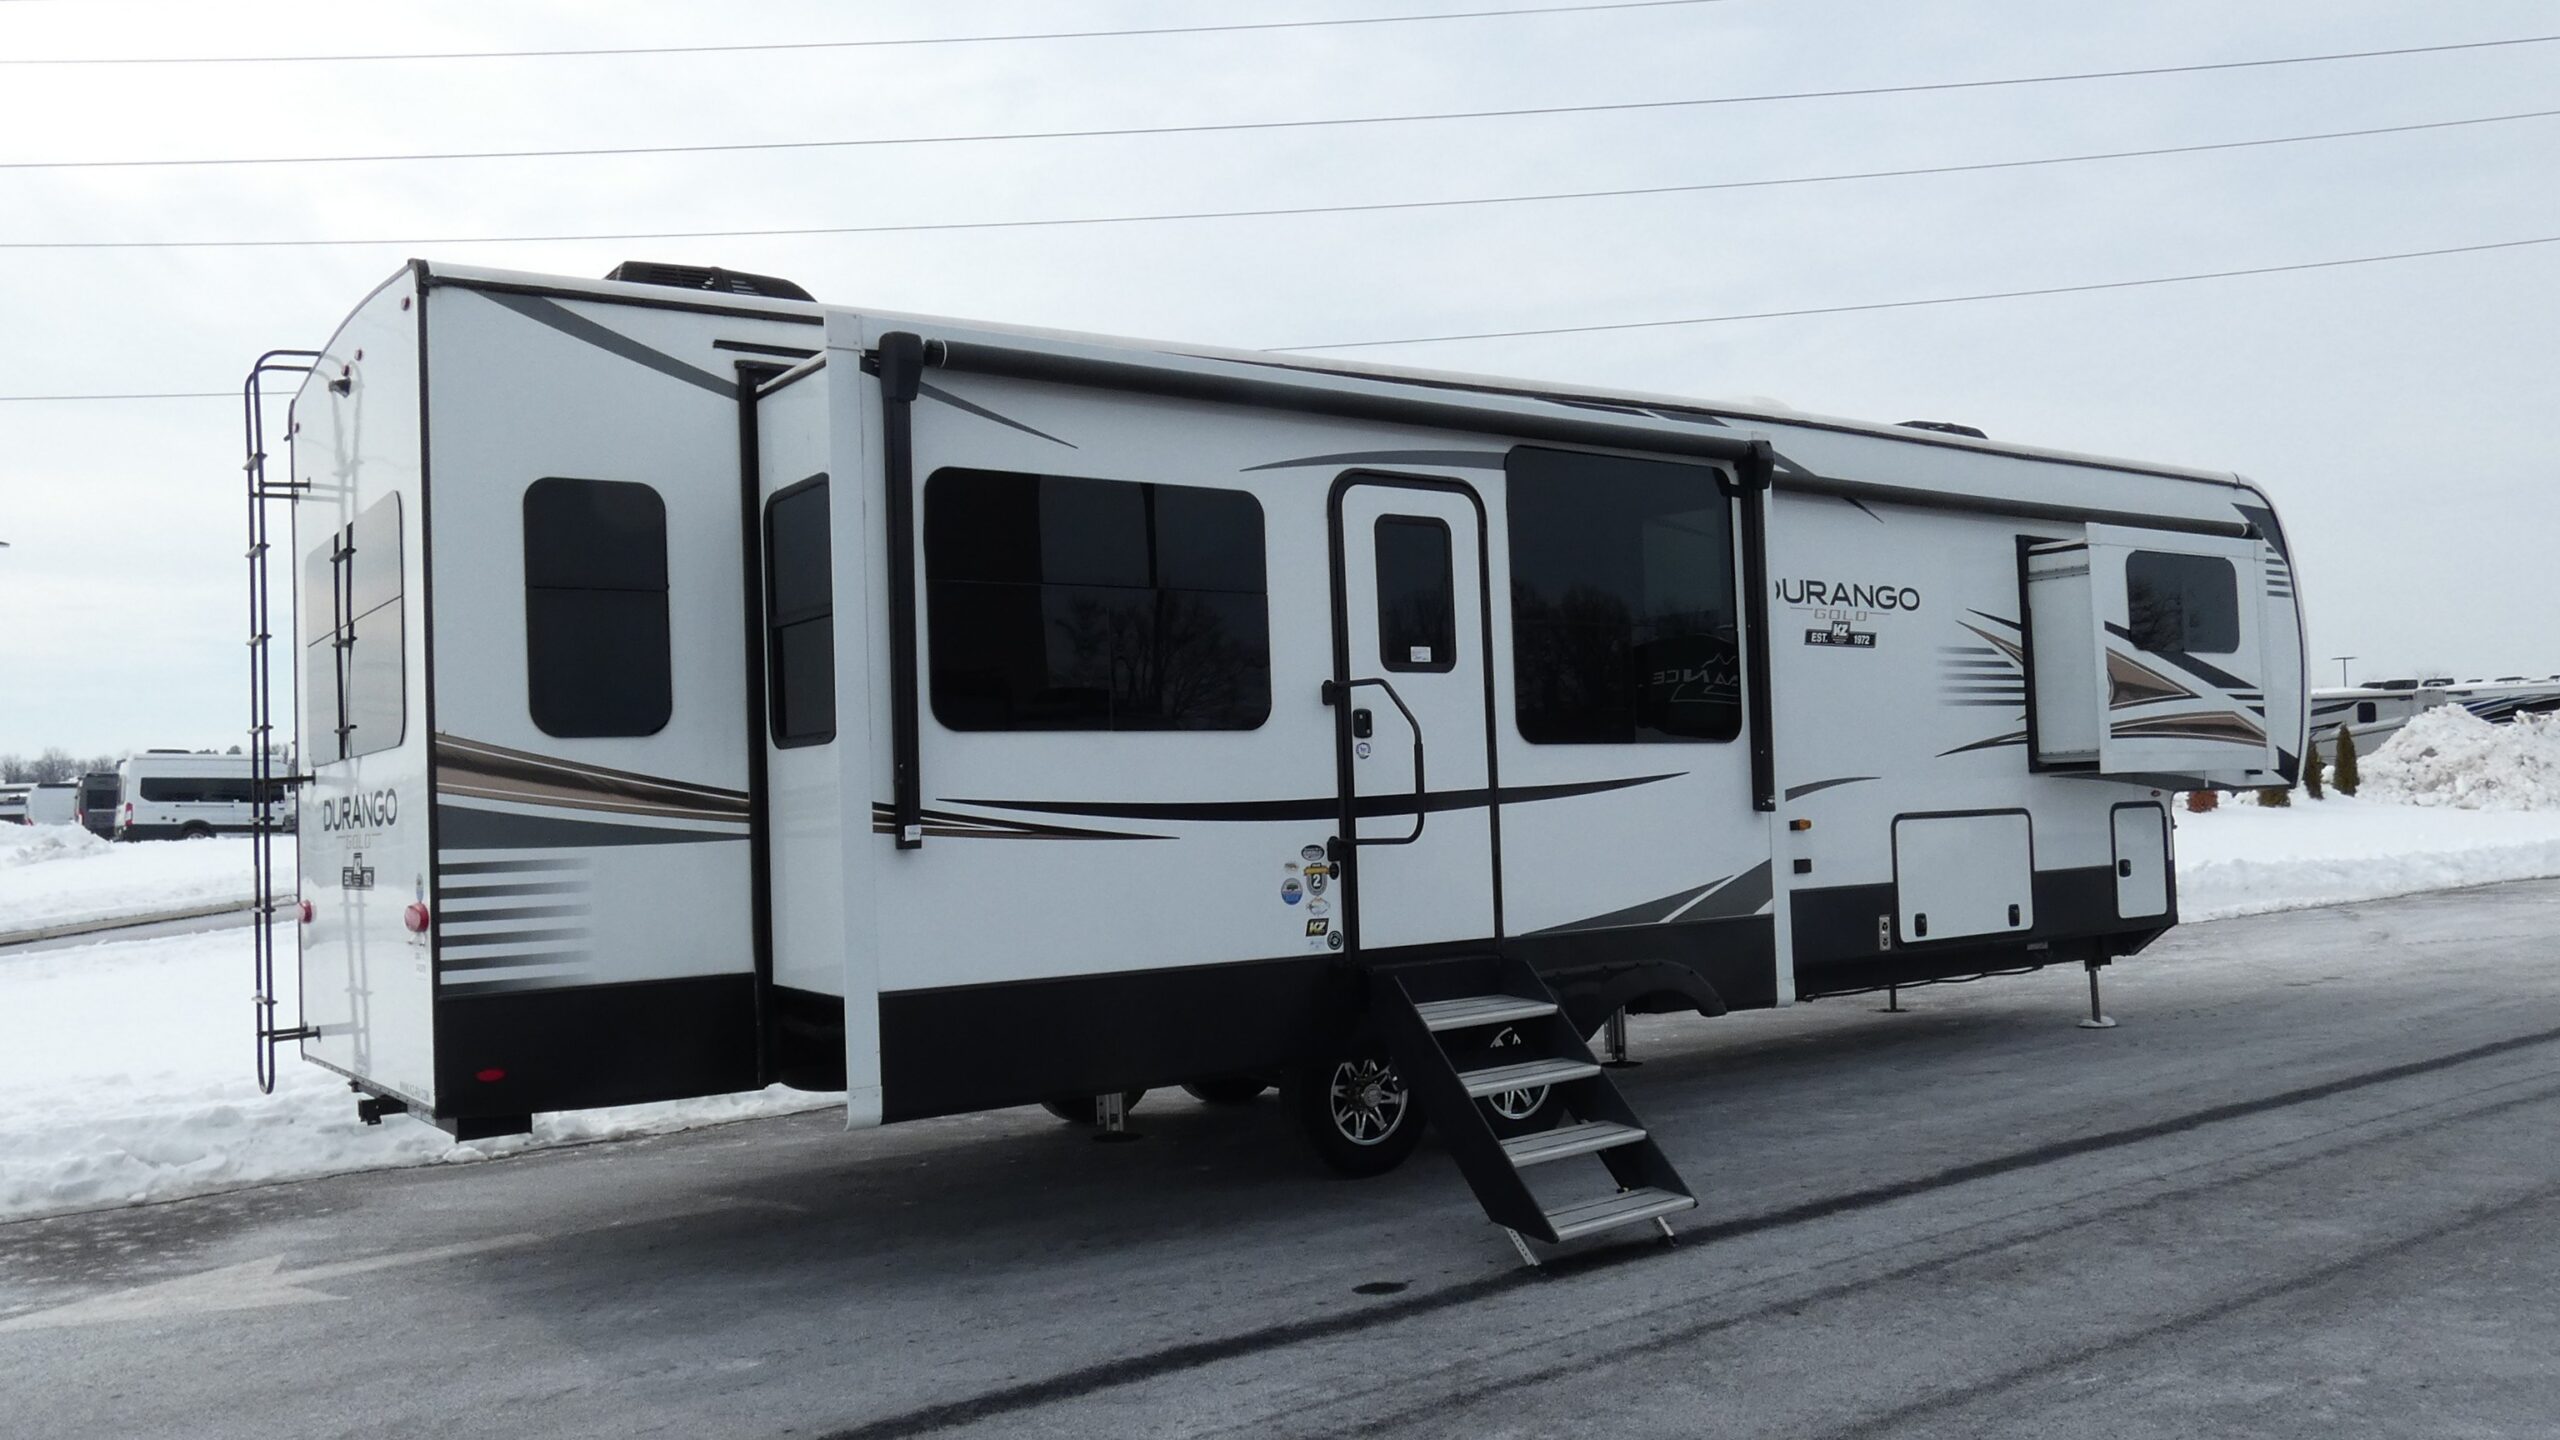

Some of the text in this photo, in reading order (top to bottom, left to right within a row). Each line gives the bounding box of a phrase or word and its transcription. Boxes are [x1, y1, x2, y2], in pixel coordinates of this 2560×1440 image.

[1814, 608, 1868, 622] GOLD
[1833, 624, 1849, 637] KZ
[1811, 632, 1828, 643] EST.
[1854, 634, 1870, 645] 1972
[324, 788, 397, 831] DURANGO
[1312, 874, 1321, 887] 2
